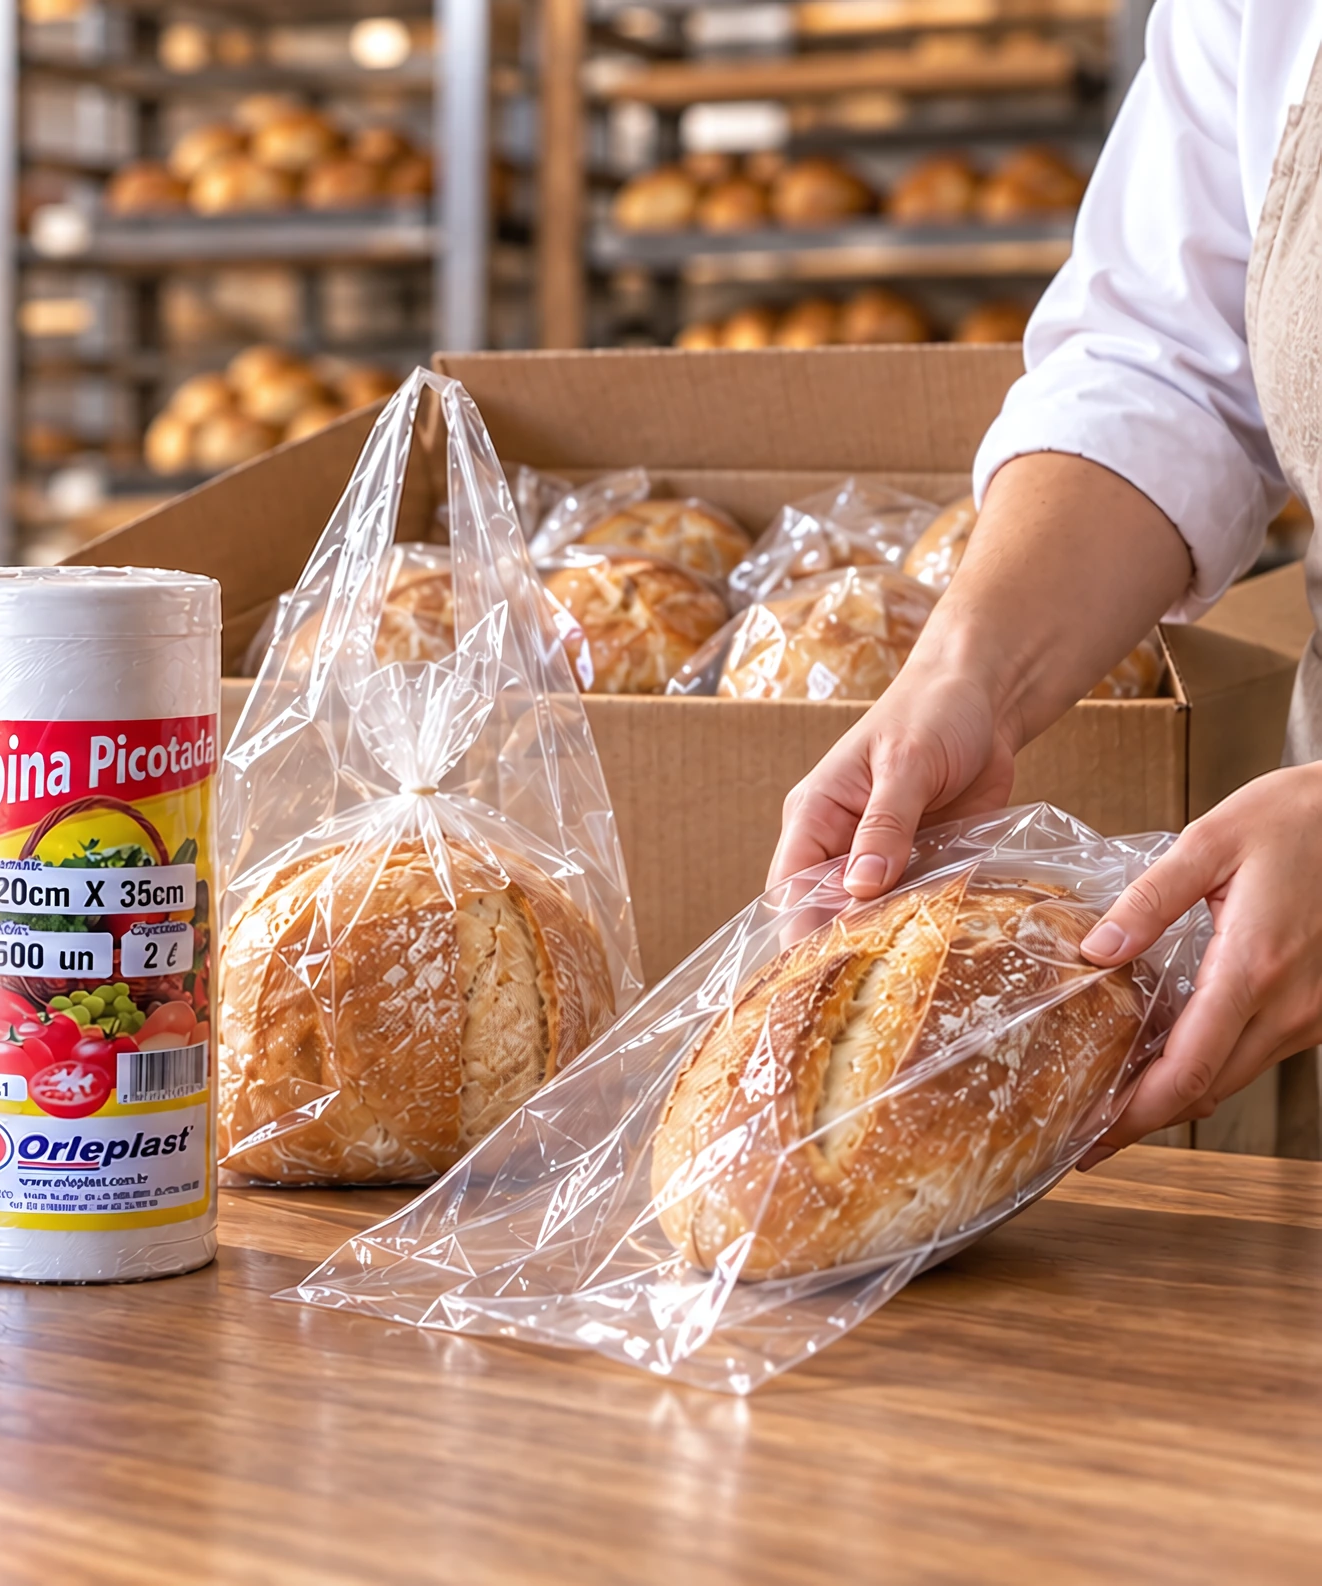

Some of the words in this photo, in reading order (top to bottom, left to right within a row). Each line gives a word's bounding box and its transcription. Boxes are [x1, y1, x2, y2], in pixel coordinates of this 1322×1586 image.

[88, 729, 215, 789] Picotada
[84, 880, 105, 907] X
[120, 880, 184, 908] 35cm
[59, 948, 94, 971] un
[143, 942, 158, 969] 2
[17, 1126, 190, 1167] Orleplast
